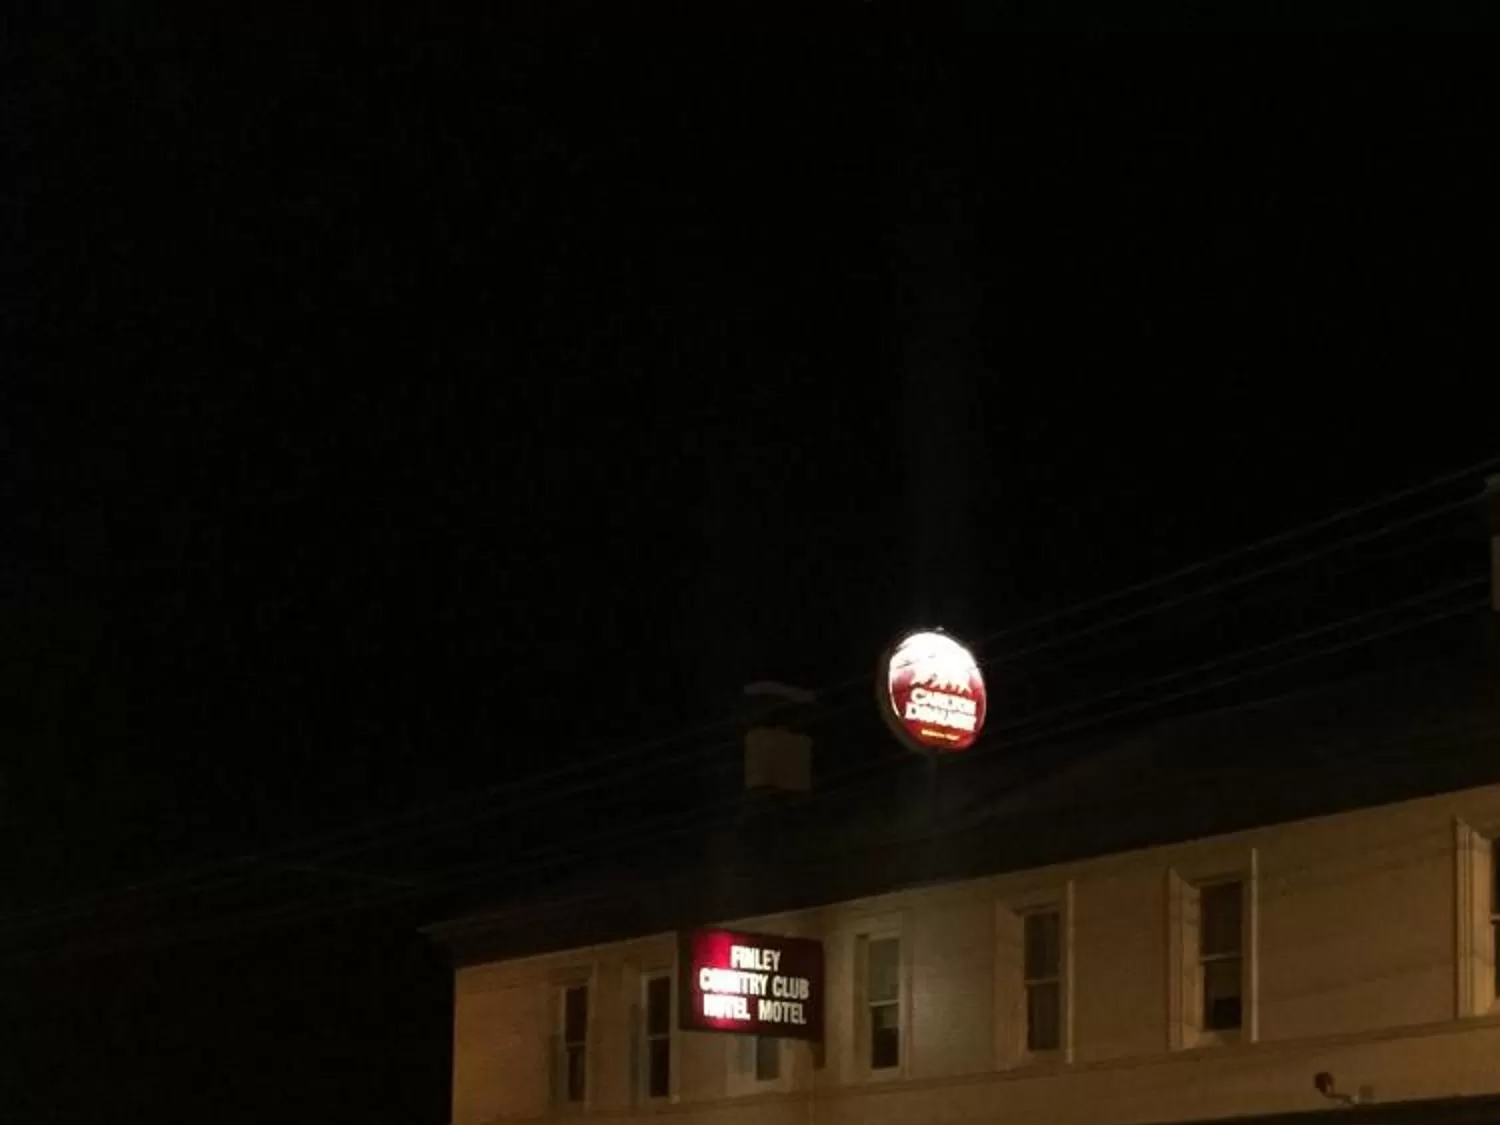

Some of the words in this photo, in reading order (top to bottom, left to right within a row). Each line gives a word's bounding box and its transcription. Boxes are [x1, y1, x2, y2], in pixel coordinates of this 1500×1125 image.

[700, 967, 769, 995] CTRY
[772, 975, 810, 1000] CLUB
[703, 994, 751, 1020] TEL
[758, 1000, 807, 1024] MOTEL
